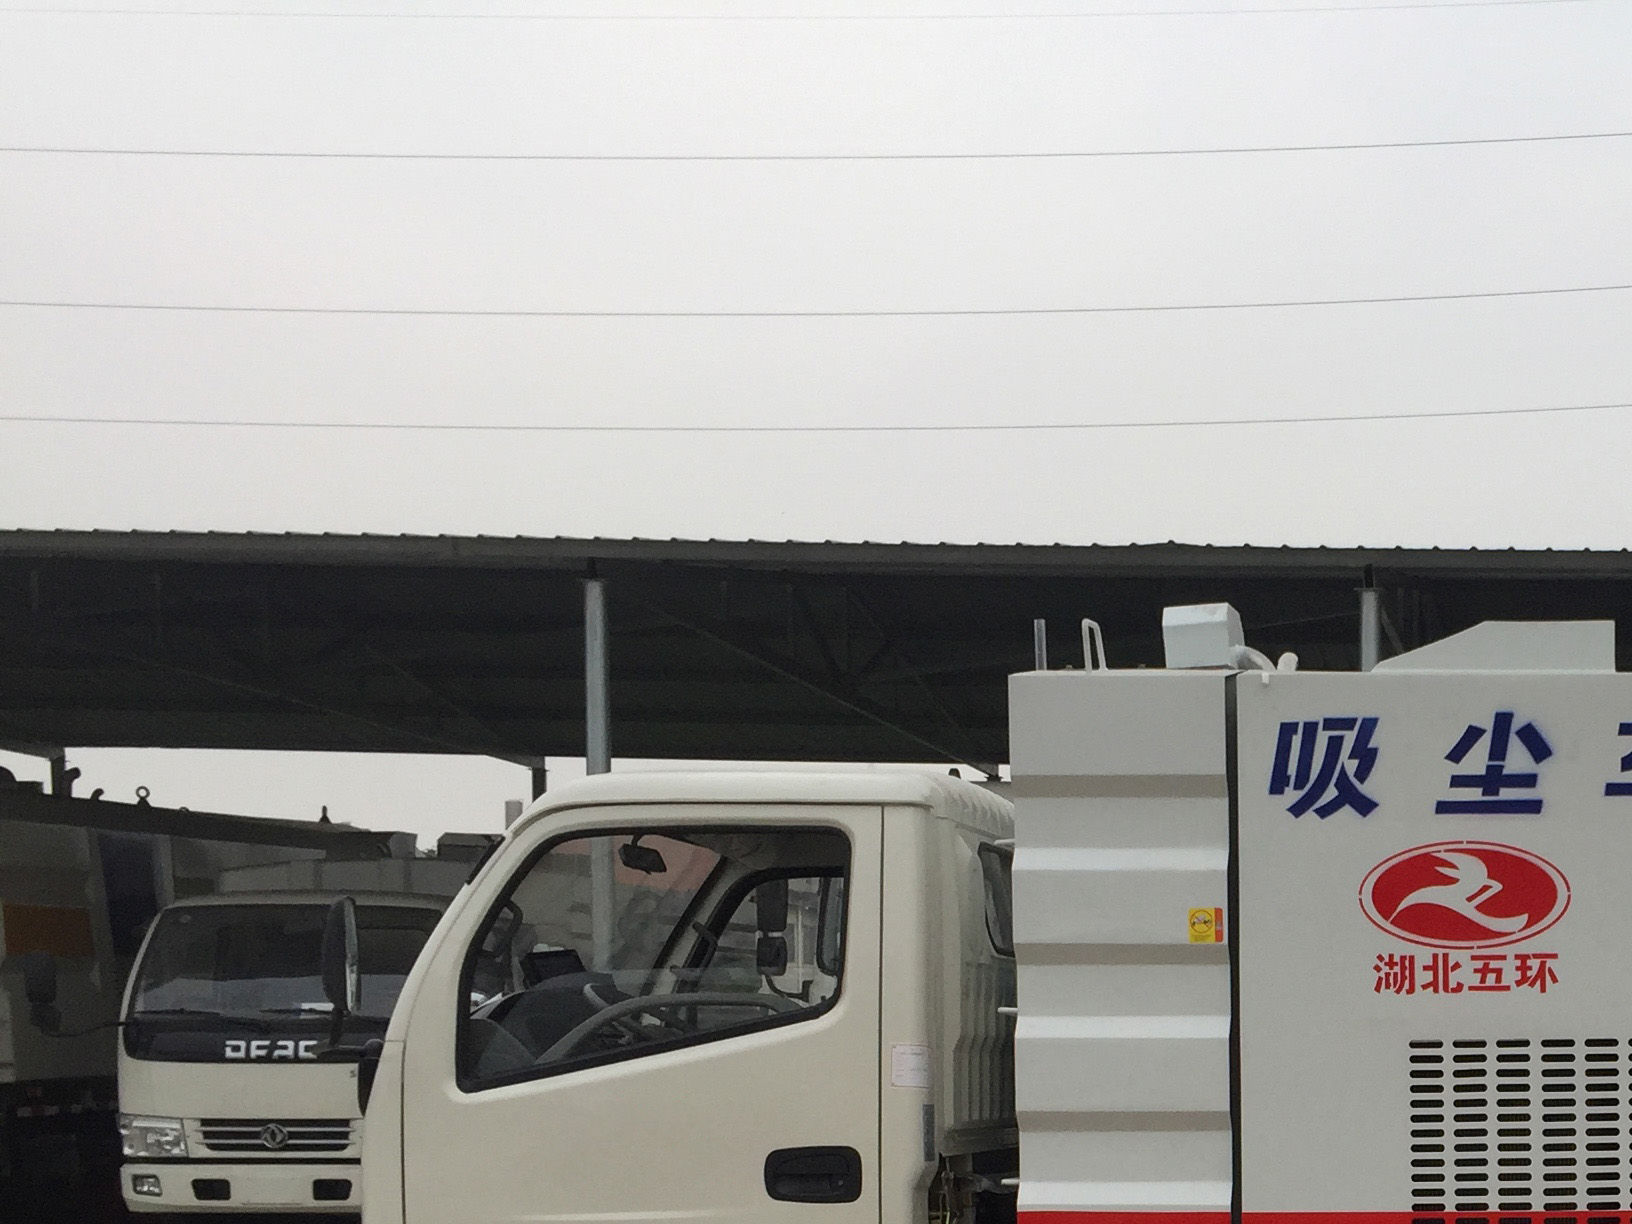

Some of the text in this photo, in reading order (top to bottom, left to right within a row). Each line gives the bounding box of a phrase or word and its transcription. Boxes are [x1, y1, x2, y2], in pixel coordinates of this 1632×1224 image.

[1372, 952, 1560, 995] 湖北五环
[225, 1040, 318, 1060] DFAC
